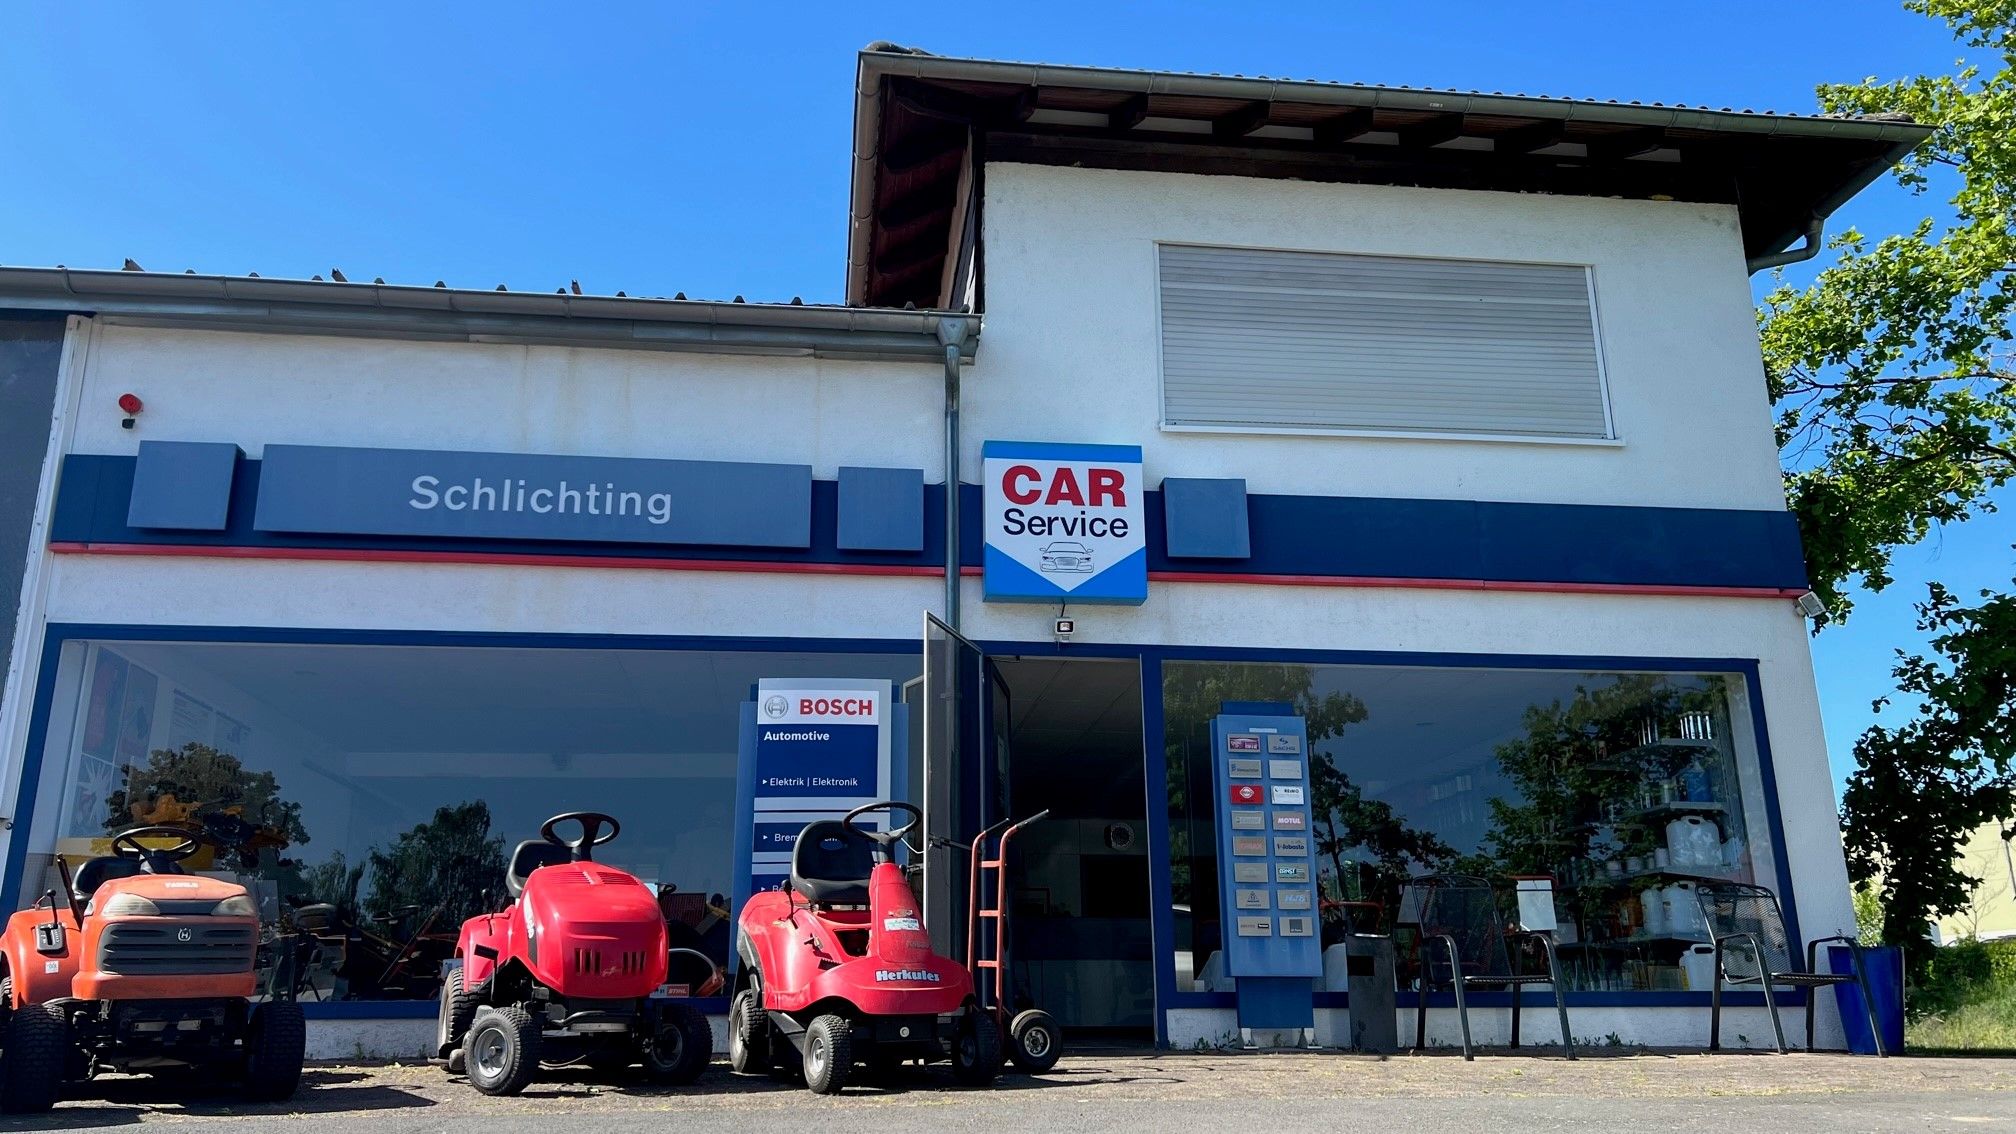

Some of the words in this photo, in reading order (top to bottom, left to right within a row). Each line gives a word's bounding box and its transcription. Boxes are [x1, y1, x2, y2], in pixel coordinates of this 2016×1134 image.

[1002, 465, 1126, 507] CAR
[409, 475, 672, 524] Schlichting
[1003, 508, 1129, 538] Service
[800, 699, 873, 716] BOSCH
[763, 730, 830, 741] Automotive
[769, 777, 804, 786] Elektrik
[812, 777, 858, 786] Elektronik
[875, 969, 940, 982] Herkules
